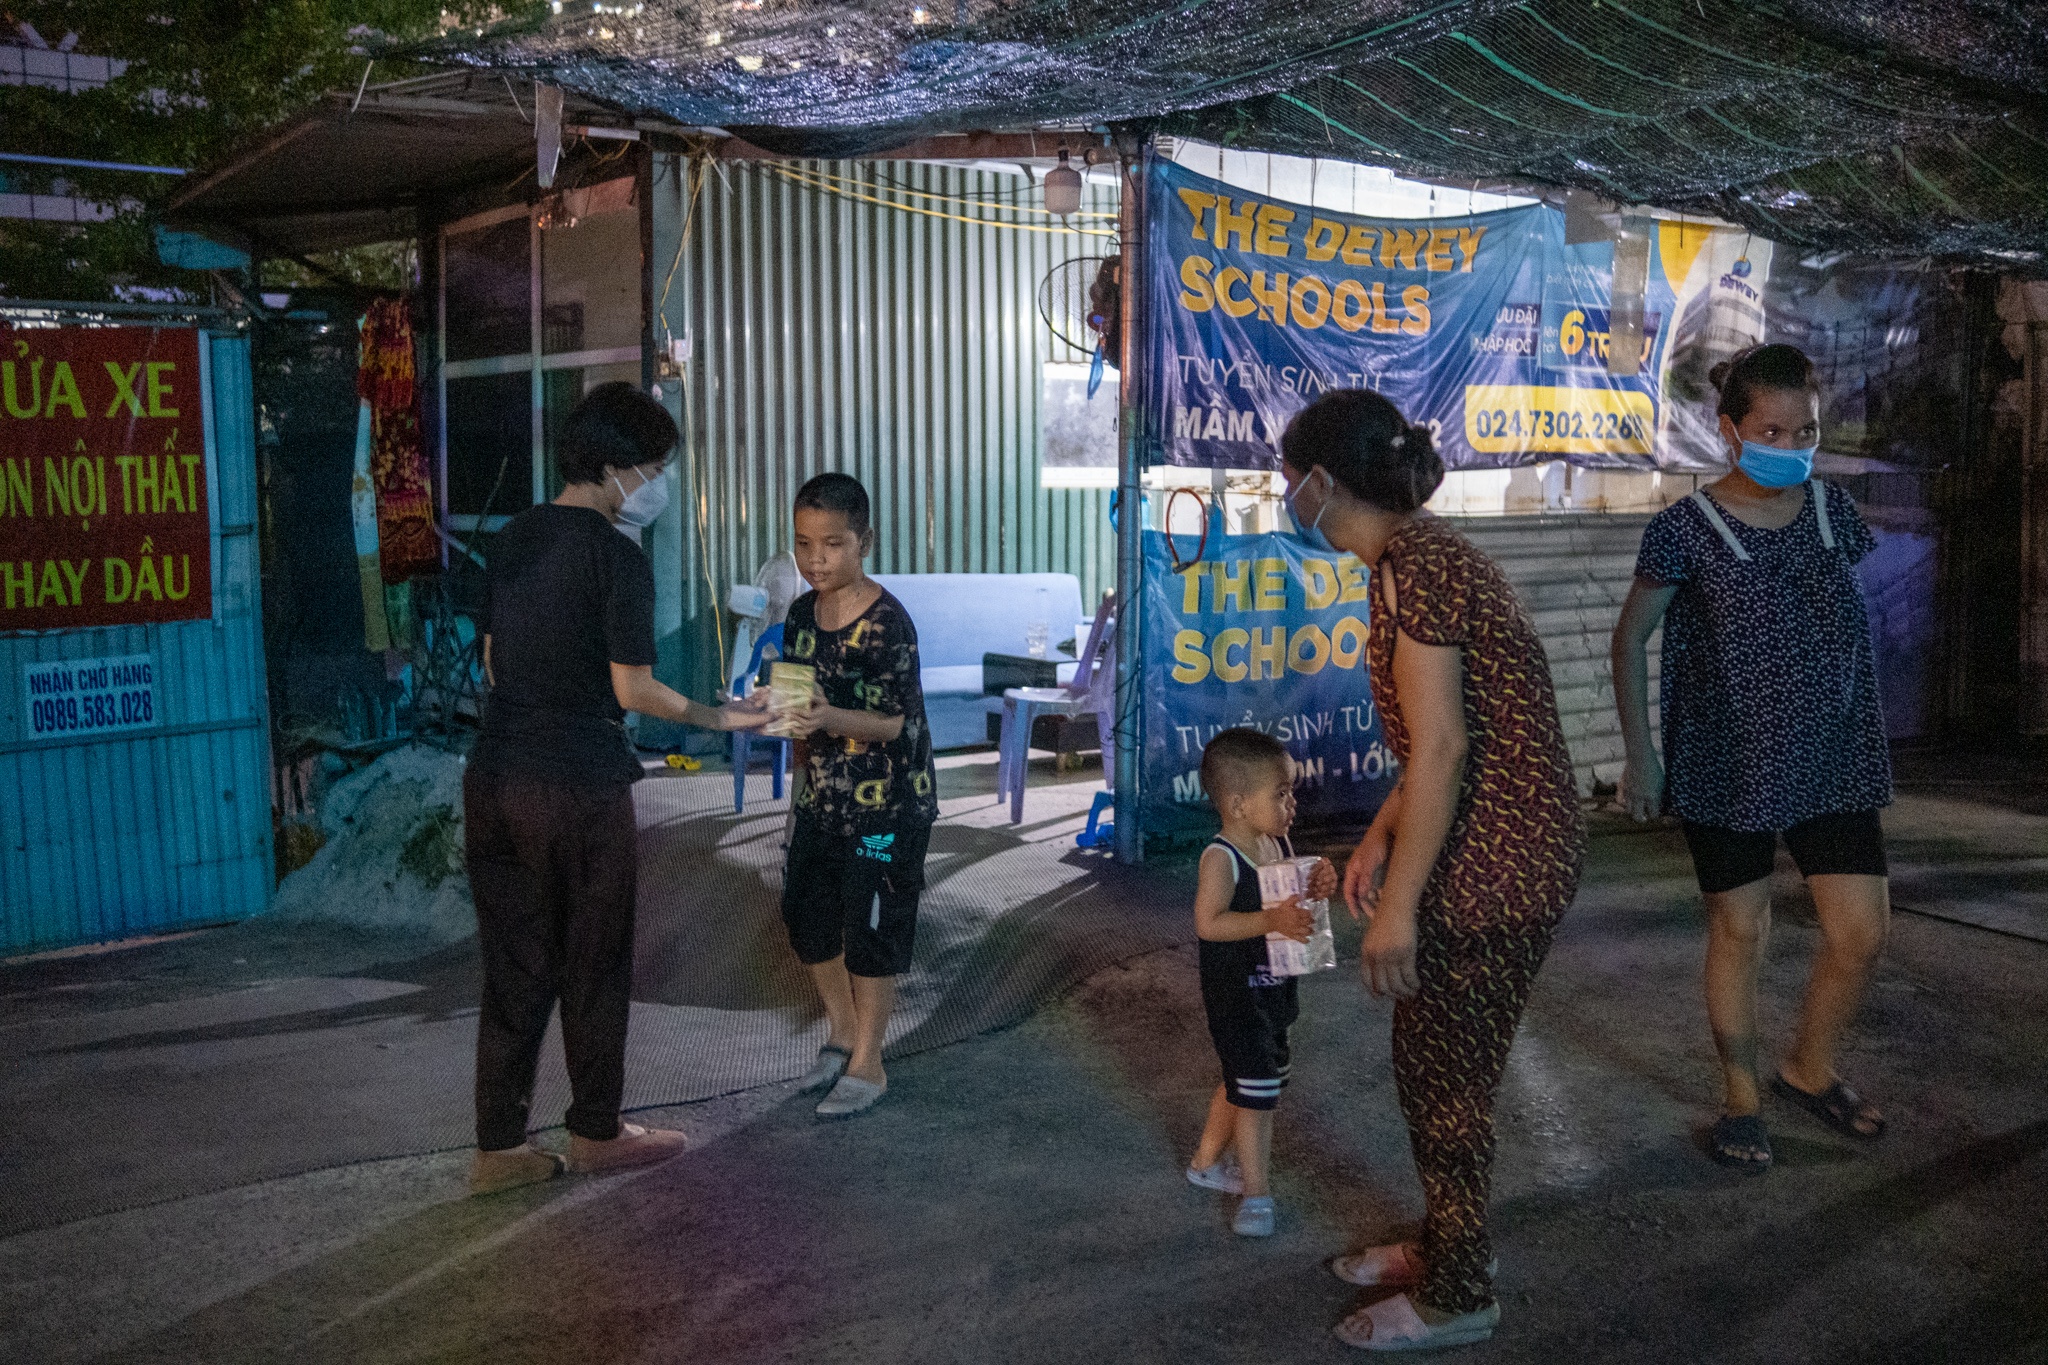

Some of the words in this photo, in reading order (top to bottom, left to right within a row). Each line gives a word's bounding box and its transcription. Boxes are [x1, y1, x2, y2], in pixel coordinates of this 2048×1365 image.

[1178, 187, 1296, 257] THE
[1304, 217, 1488, 273] DEWEY
[1178, 255, 1432, 336] SCHOOLS
[1560, 310, 1585, 355] 6
[0, 340, 88, 419] ỬA
[104, 360, 180, 419] XE
[1175, 391, 1255, 443] MẦM
[45, 438, 107, 532] NỘI
[116, 428, 200, 516] THẤT
[105, 535, 190, 604] DẦU
[1172, 557, 1288, 614] THE
[1172, 616, 1371, 684] SCHOO
[33, 690, 154, 733] 0989.583.028
[1277, 711, 1335, 742] SINH
